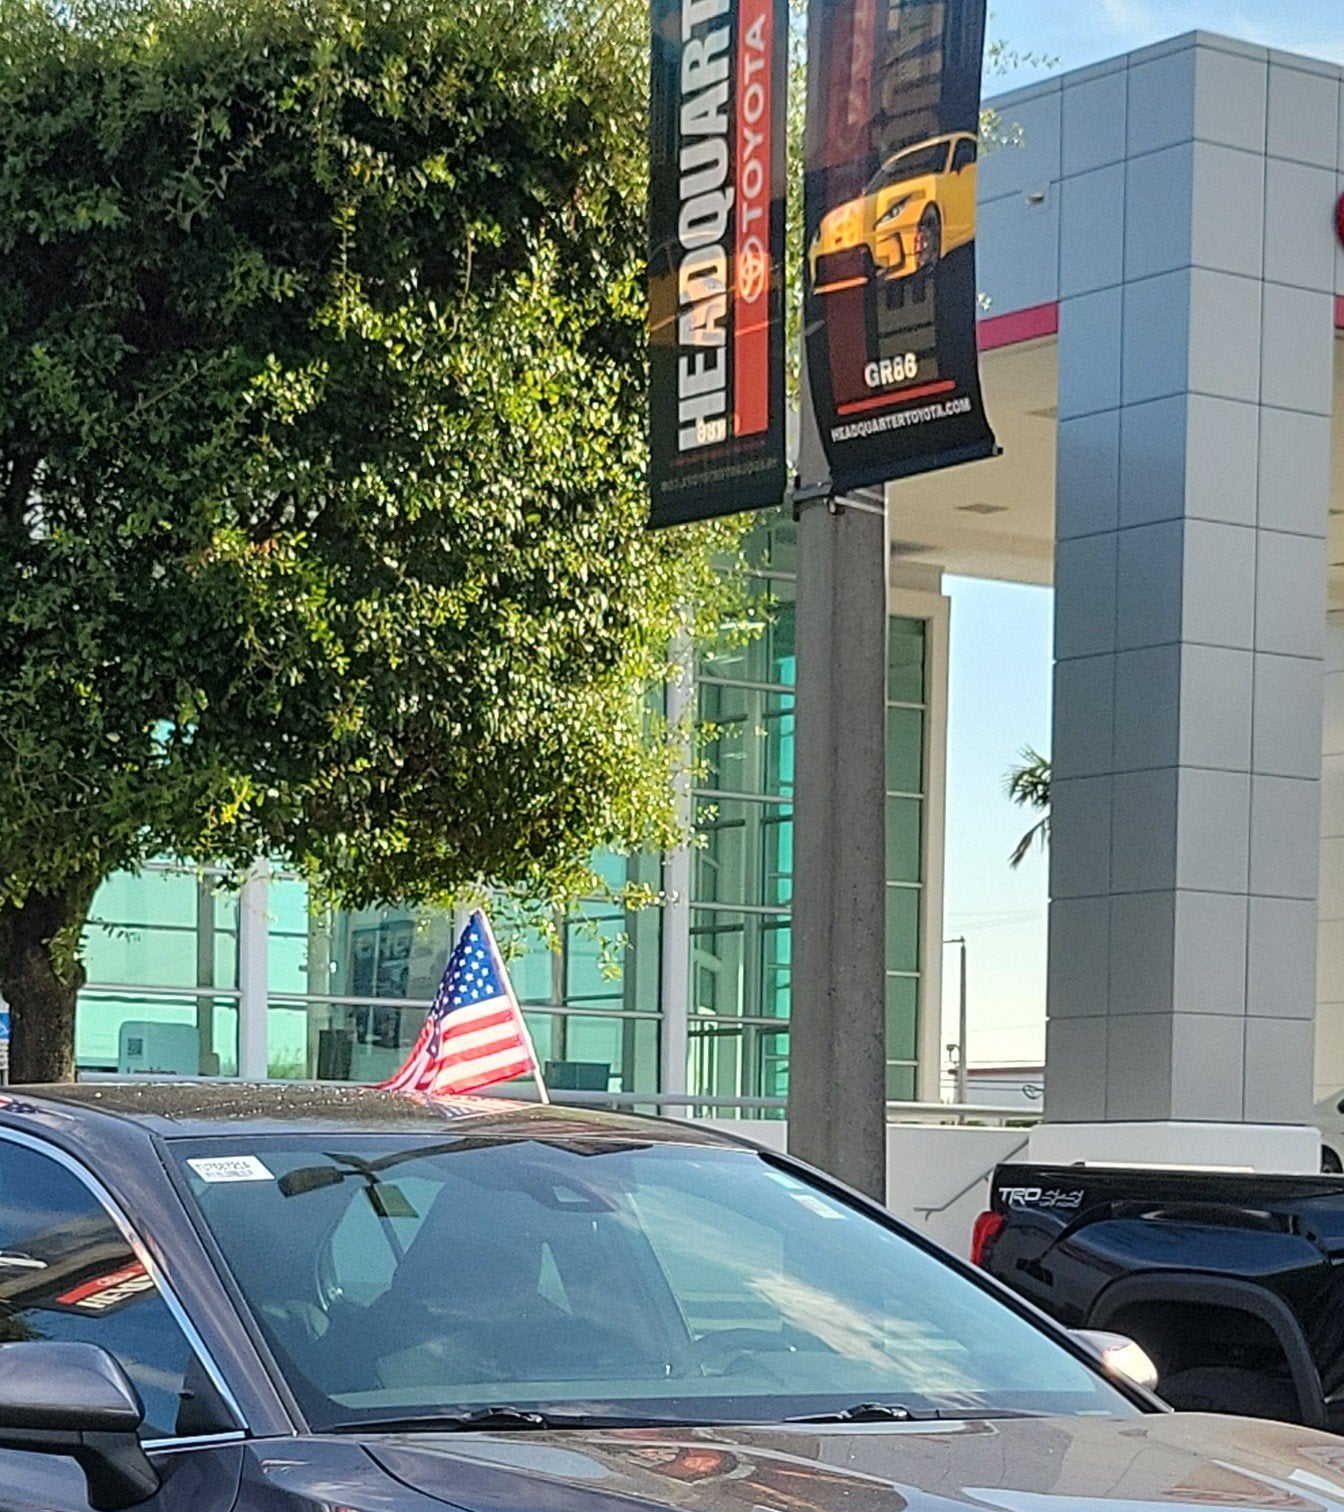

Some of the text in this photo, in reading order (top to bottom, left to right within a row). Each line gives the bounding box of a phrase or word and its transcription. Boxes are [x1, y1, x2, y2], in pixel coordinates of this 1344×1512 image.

[741, 13, 767, 227] TOYOTA
[864, 352, 918, 388] GR86
[830, 397, 972, 443] HEADQUARTERTOYOTA.COM
[998, 1187, 1042, 1205] TRD
